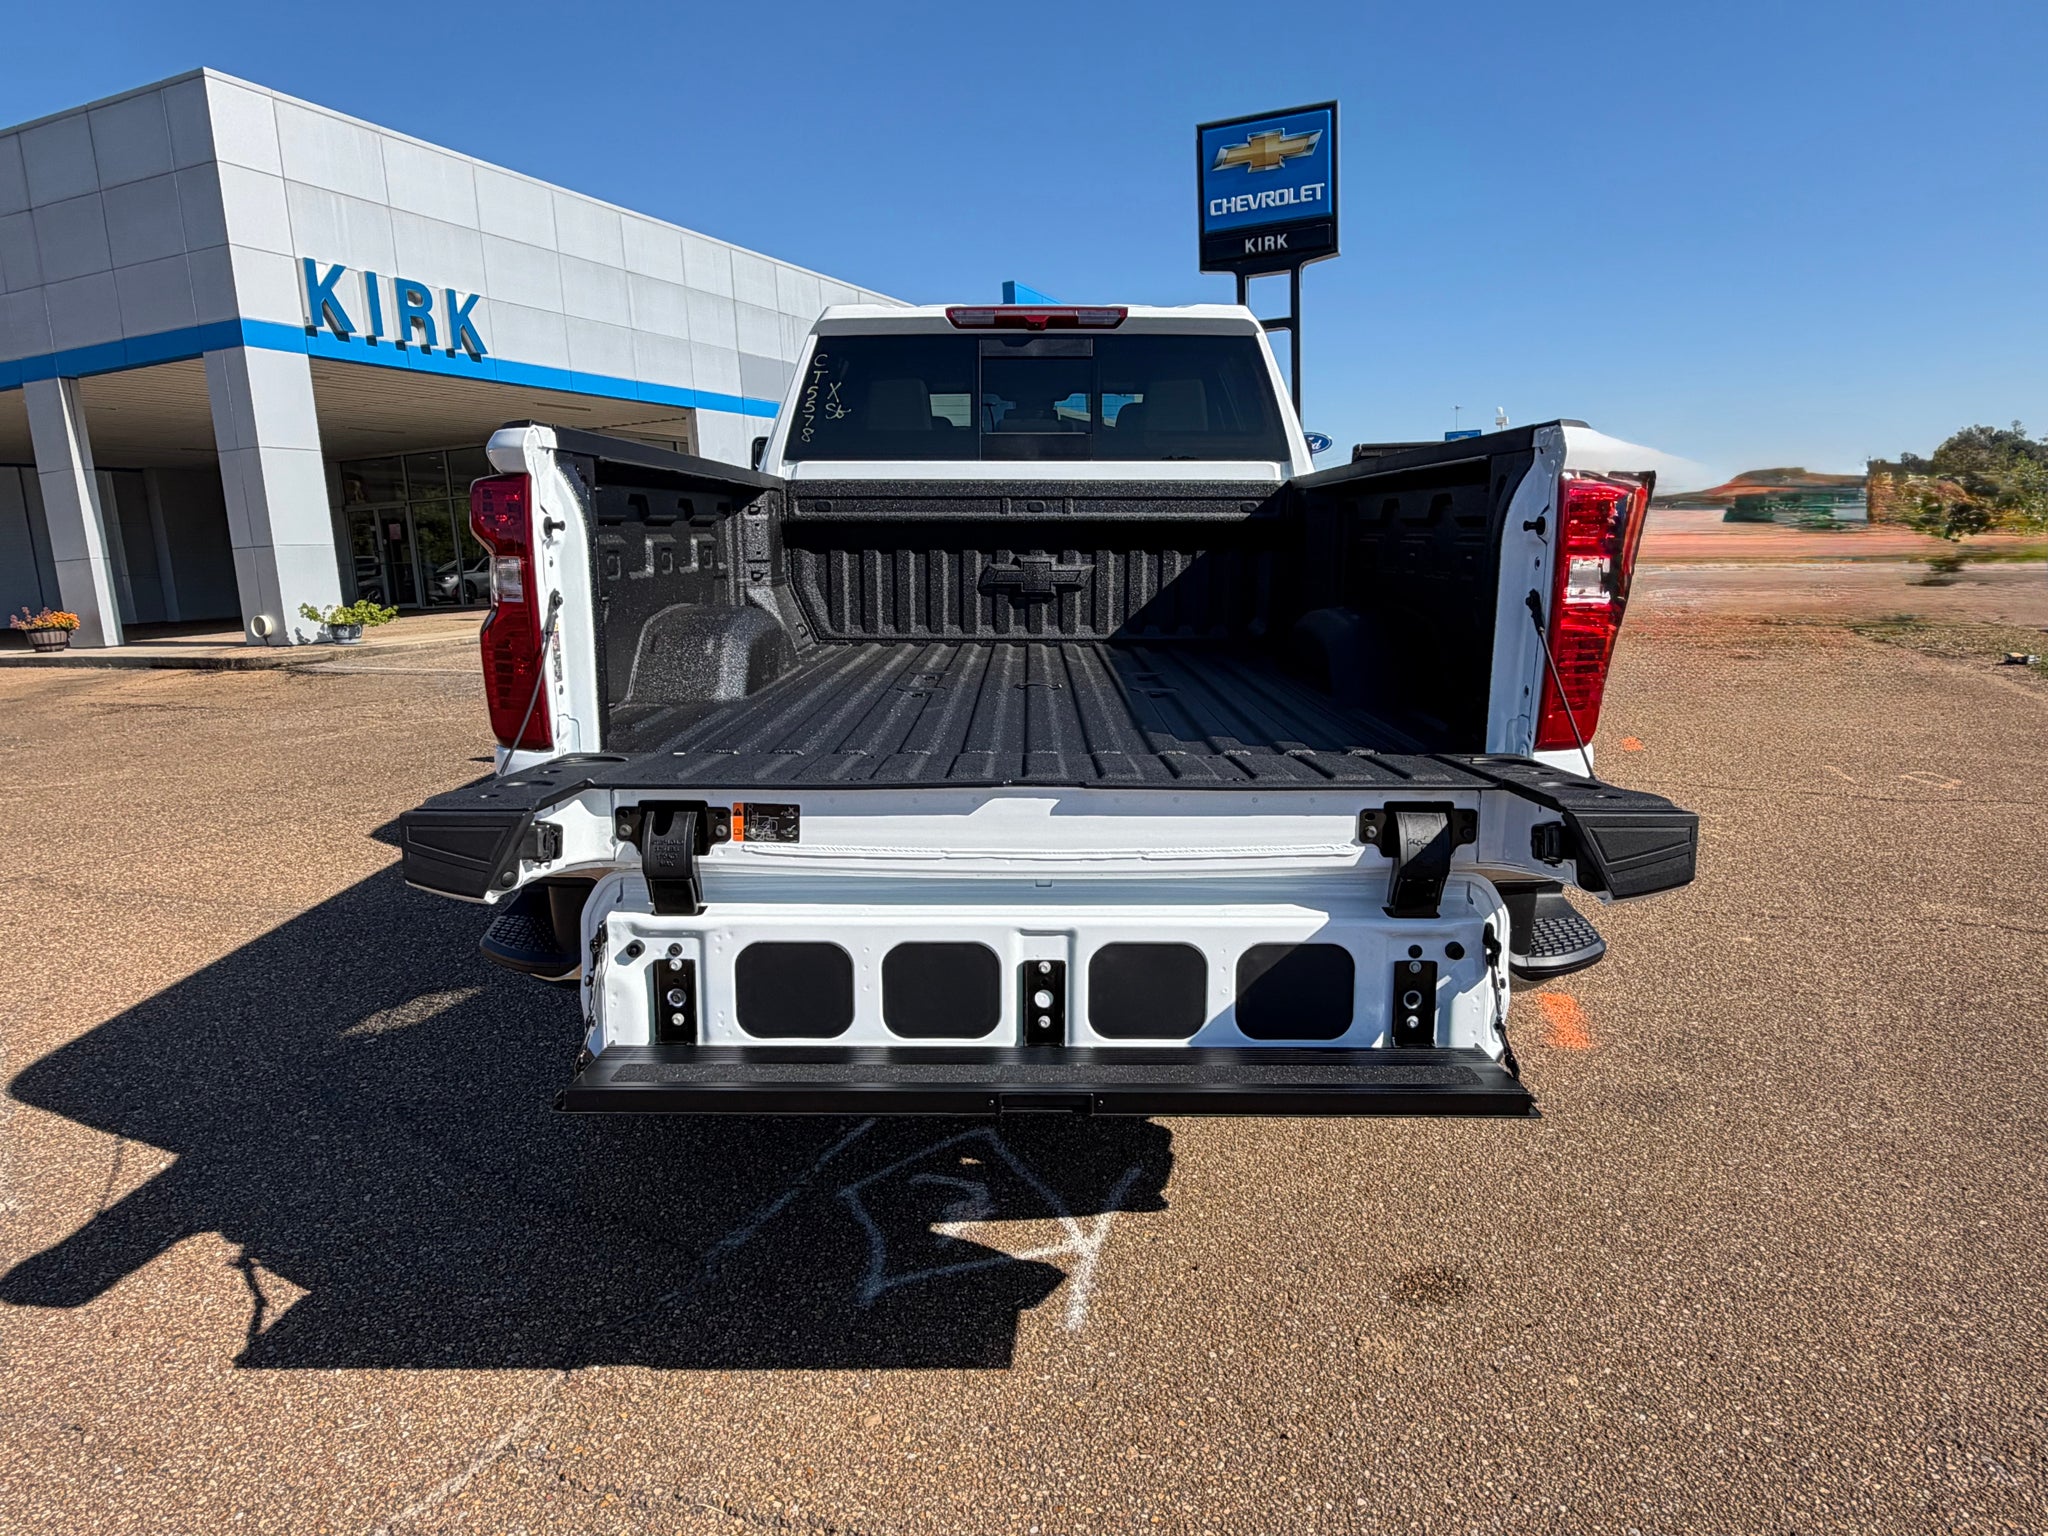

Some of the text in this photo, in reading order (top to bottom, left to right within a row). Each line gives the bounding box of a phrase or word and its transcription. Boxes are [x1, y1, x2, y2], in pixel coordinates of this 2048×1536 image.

[1209, 182, 1326, 217] CHEVROLET
[1244, 233, 1289, 254] KIRK
[301, 257, 489, 355] KIRK
